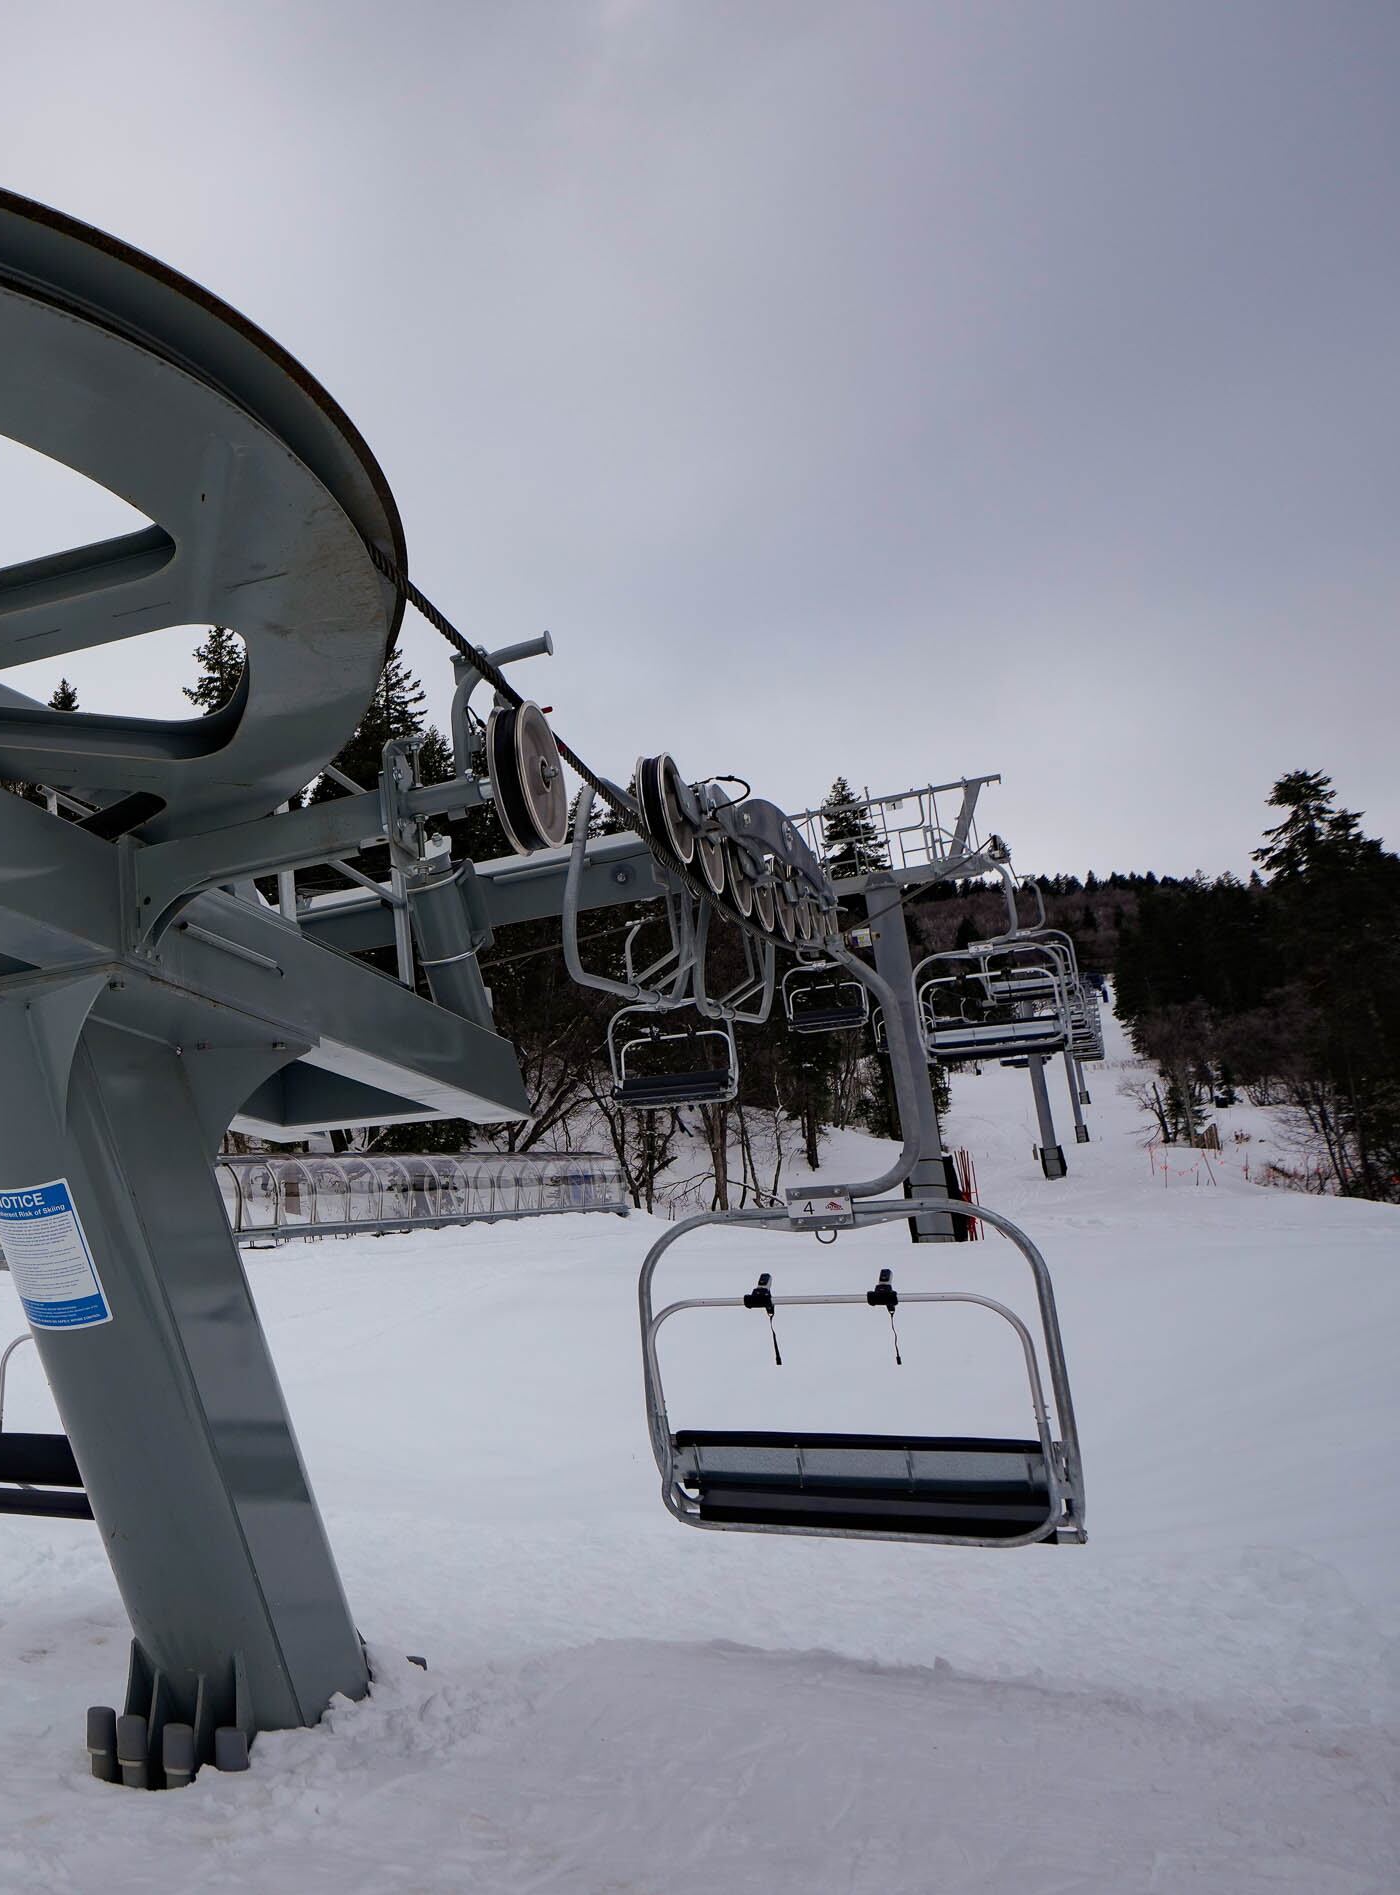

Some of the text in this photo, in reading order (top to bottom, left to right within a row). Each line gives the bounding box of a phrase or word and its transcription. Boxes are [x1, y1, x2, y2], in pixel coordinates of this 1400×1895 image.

[19, 1210, 33, 1218] Risk
[43, 1204, 65, 1214] Skiing
[803, 1201, 815, 1215] 4
